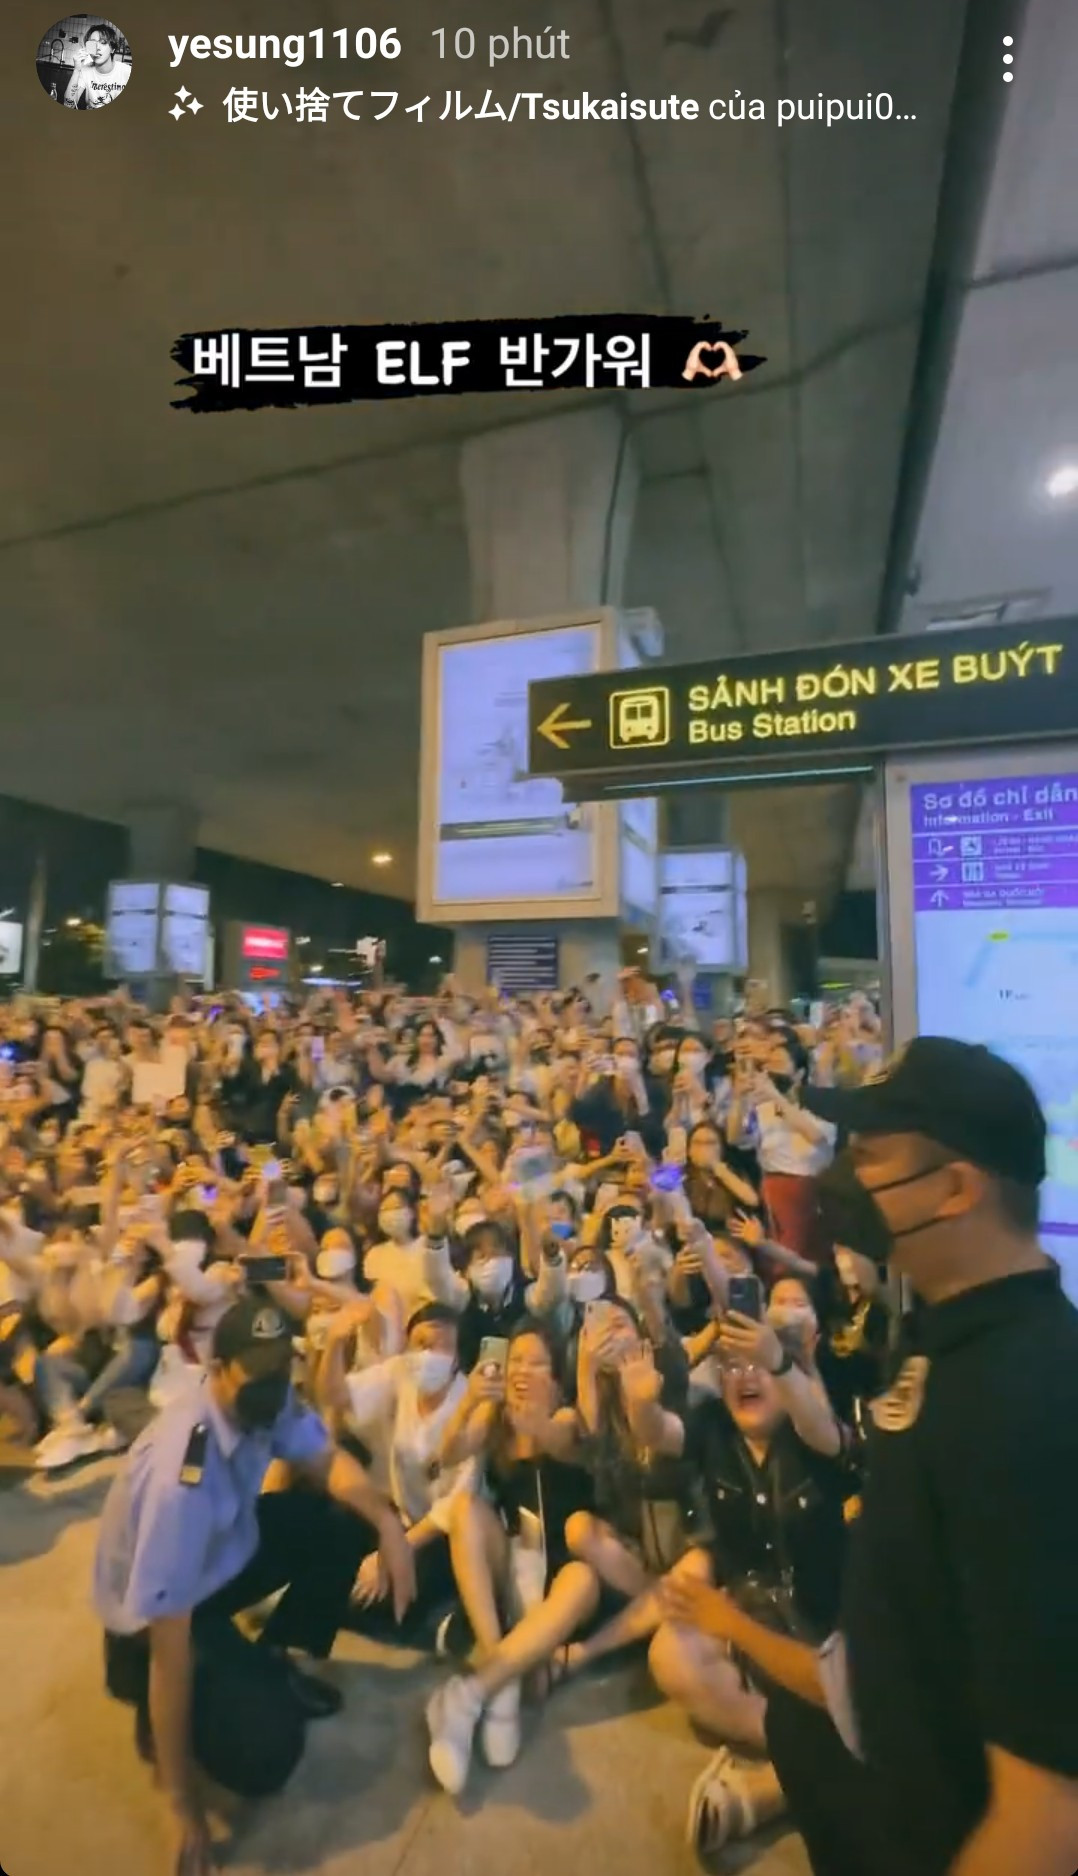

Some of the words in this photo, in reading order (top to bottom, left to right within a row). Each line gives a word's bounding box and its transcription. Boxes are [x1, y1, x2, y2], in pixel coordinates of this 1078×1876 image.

[688, 675, 785, 712] SẢNH
[795, 663, 876, 701] ĐÓN
[888, 659, 940, 692] XE
[952, 641, 1063, 684] BUÝT
[688, 719, 743, 744] Bus
[752, 709, 857, 738] Station
